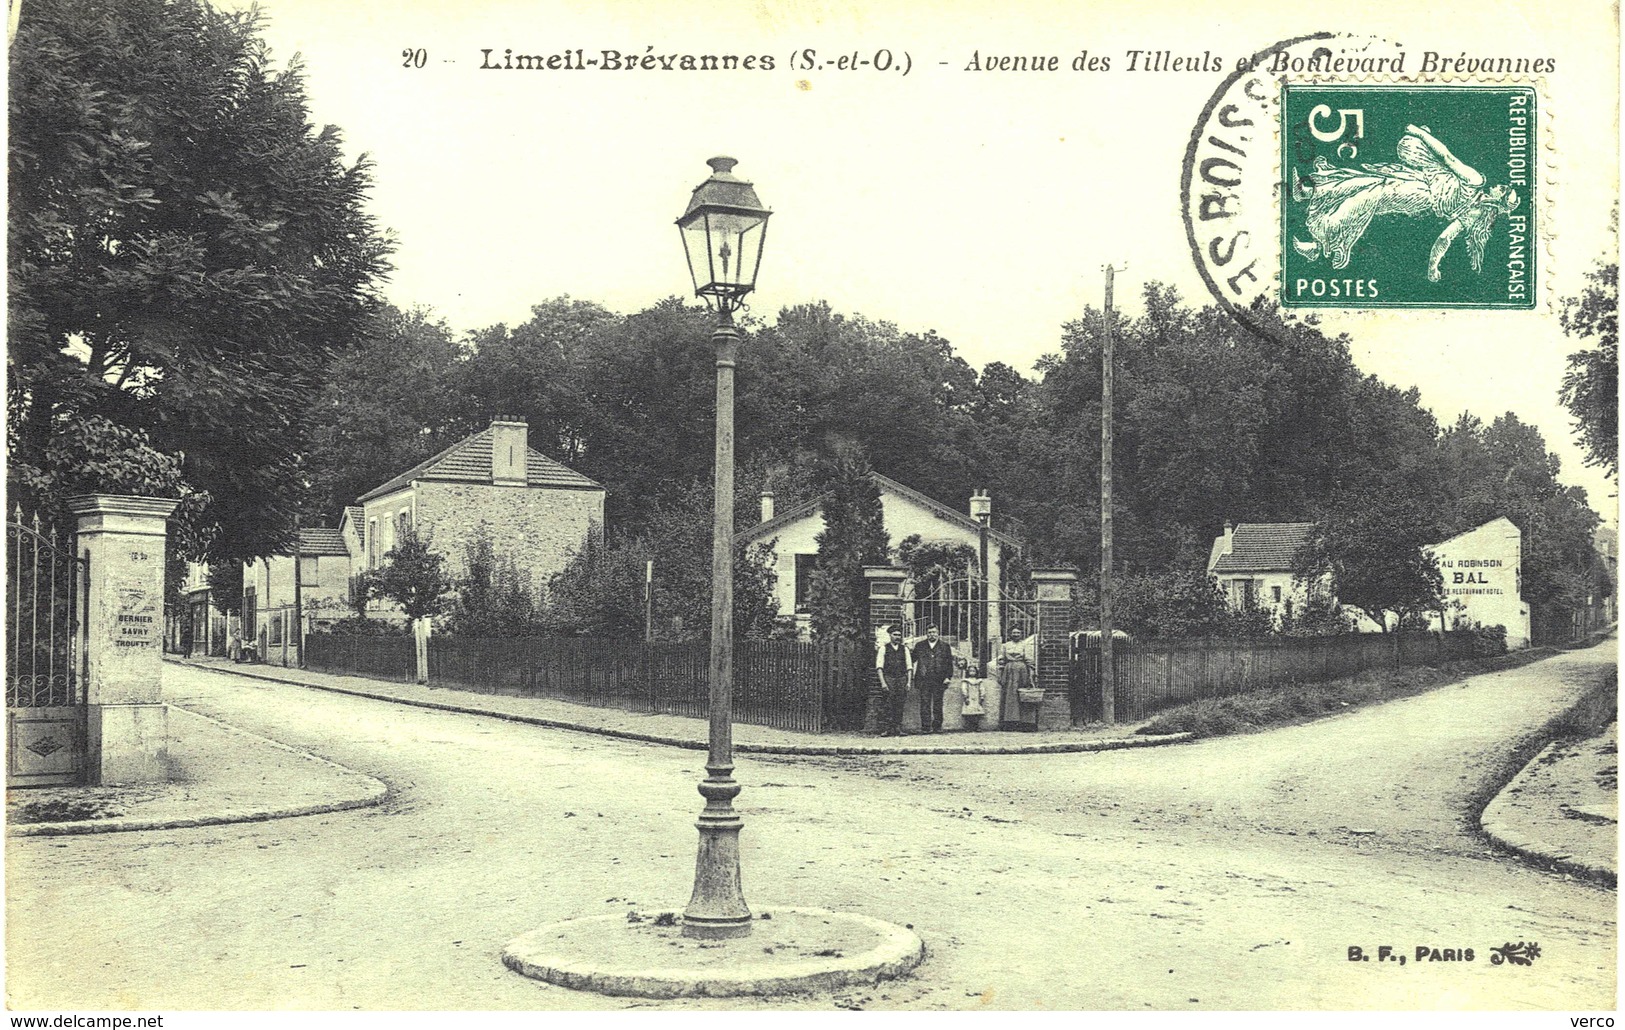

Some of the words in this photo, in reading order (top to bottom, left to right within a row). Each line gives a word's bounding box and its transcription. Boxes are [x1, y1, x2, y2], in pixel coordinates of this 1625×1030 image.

[1508, 214, 1526, 300] FRANÇAISE
[1296, 278, 1379, 298] POSTES
[1441, 560, 1454, 568] AU
[1458, 559, 1503, 568] ROBINSON
[1452, 571, 1489, 584] BAL
[118, 614, 153, 623] BERNIER
[122, 627, 149, 636] SAVRY
